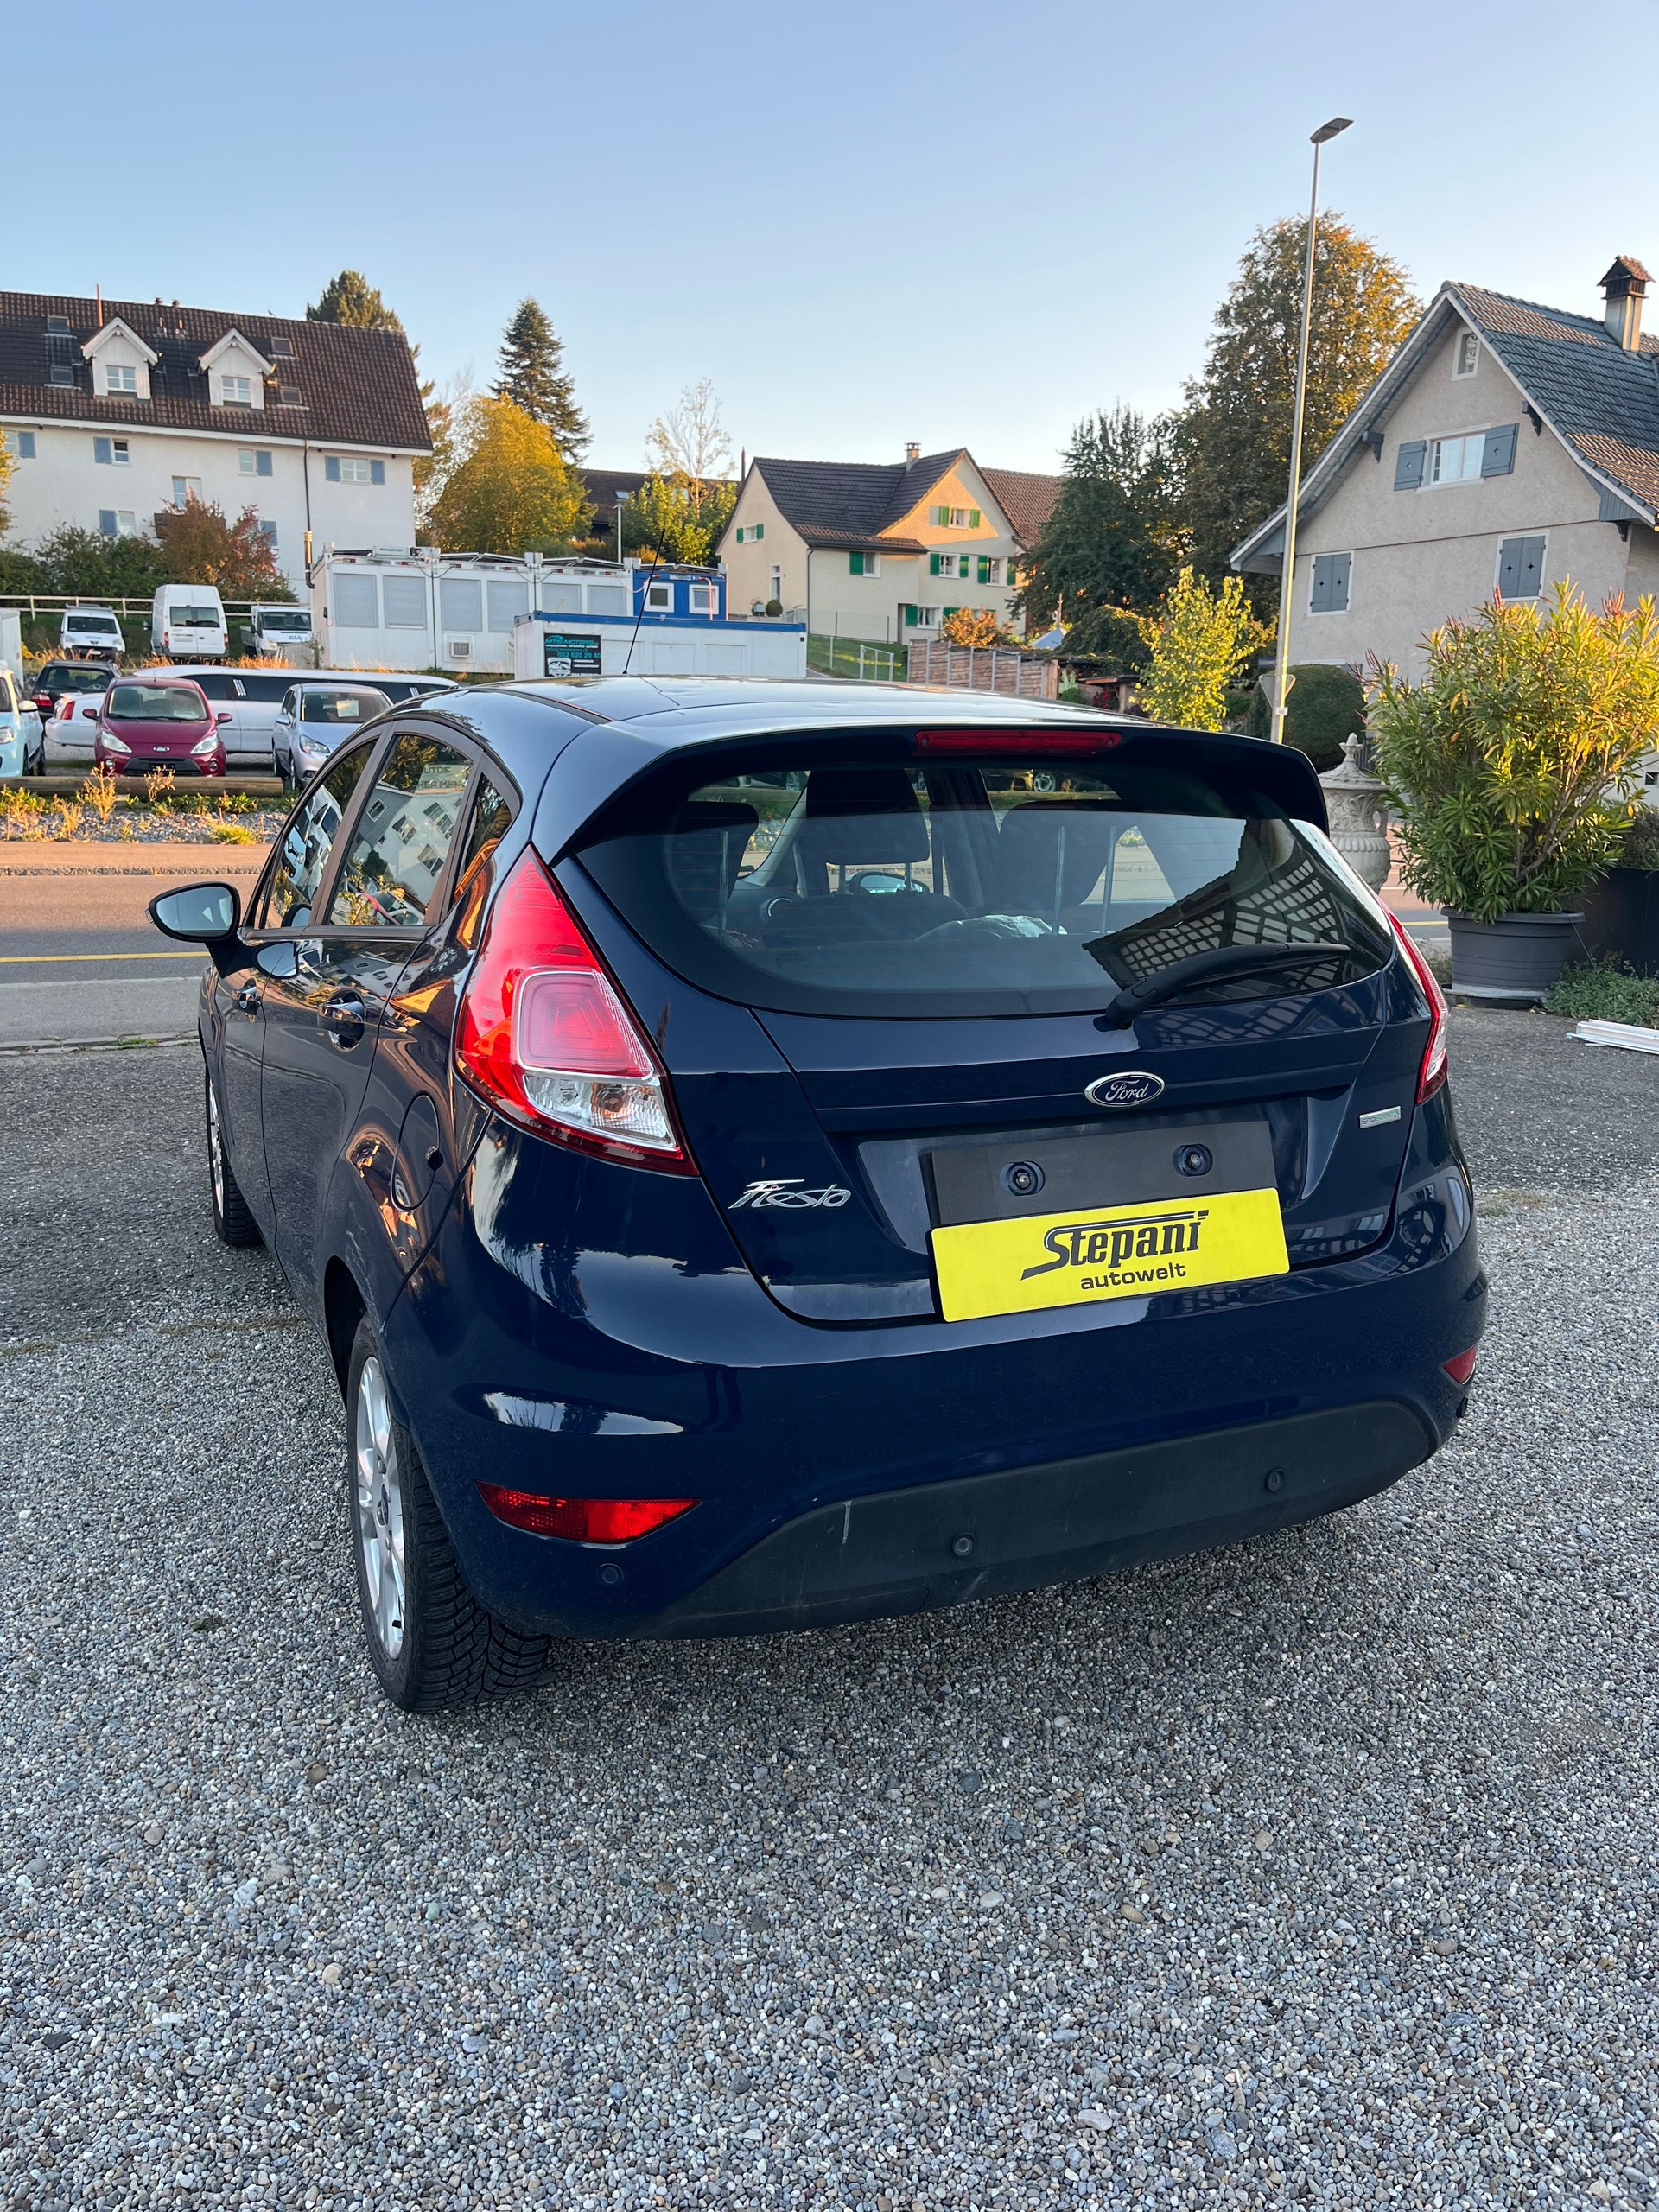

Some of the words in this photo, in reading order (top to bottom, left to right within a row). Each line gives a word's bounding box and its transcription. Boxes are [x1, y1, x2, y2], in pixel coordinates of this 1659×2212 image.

[1105, 1079, 1150, 1102] Ford
[728, 1179, 852, 1210] Fiesta
[1020, 1210, 1210, 1281] Stepani
[1080, 1262, 1187, 1290] autowelt
